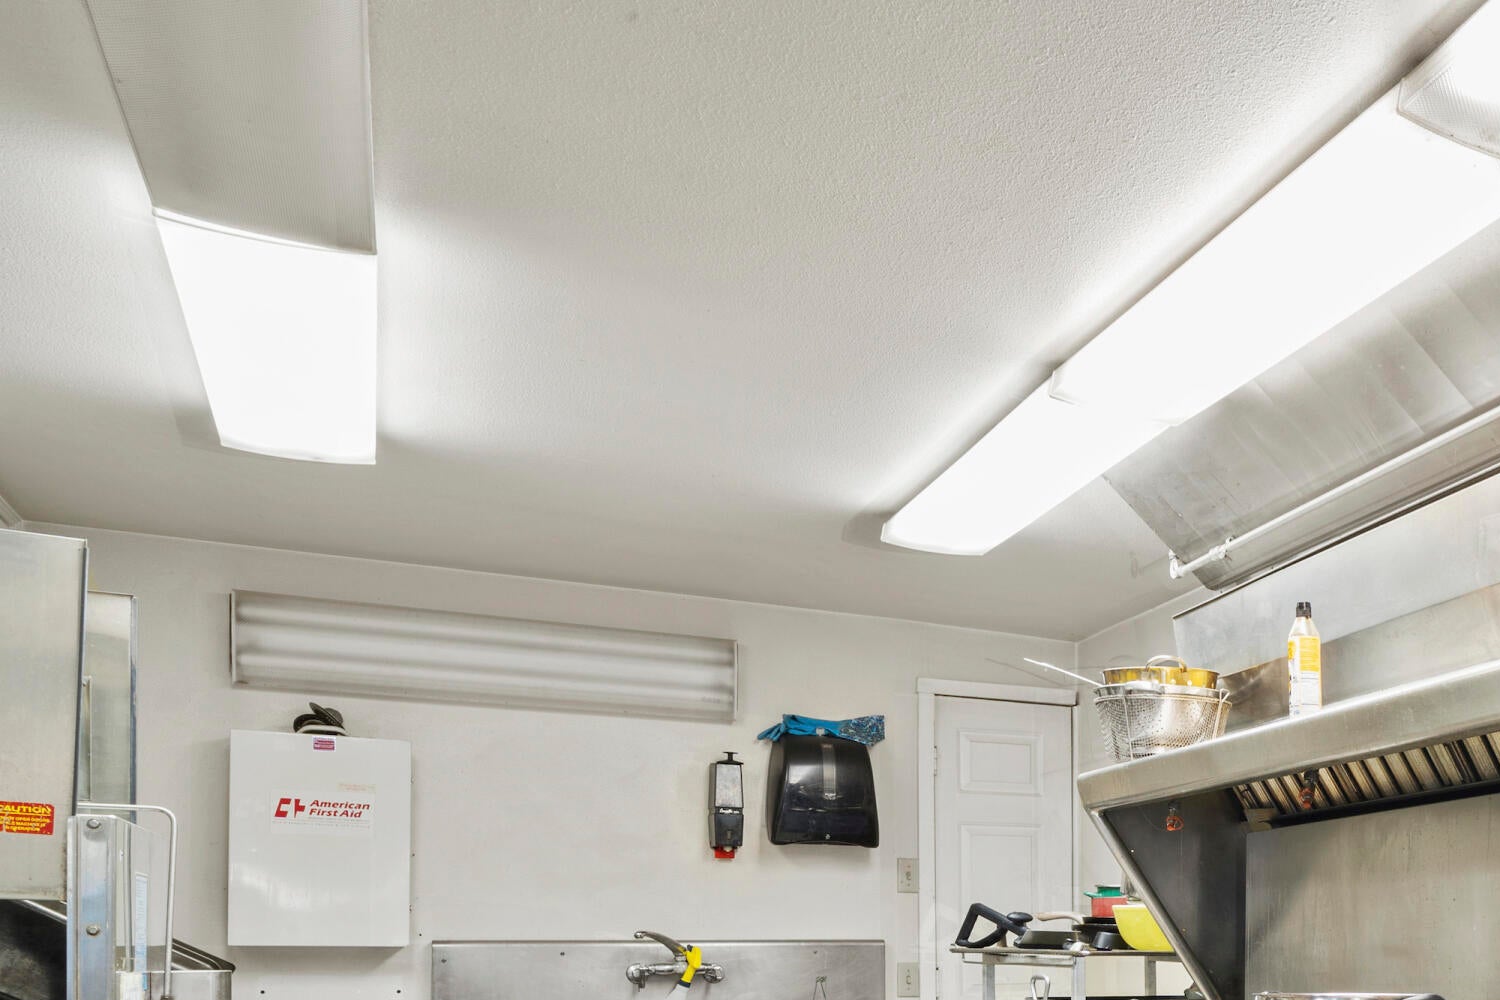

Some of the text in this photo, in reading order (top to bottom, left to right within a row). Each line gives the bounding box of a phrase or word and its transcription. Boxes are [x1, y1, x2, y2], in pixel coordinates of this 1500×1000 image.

[309, 799, 371, 811] American
[309, 808, 363, 819] First Aid
